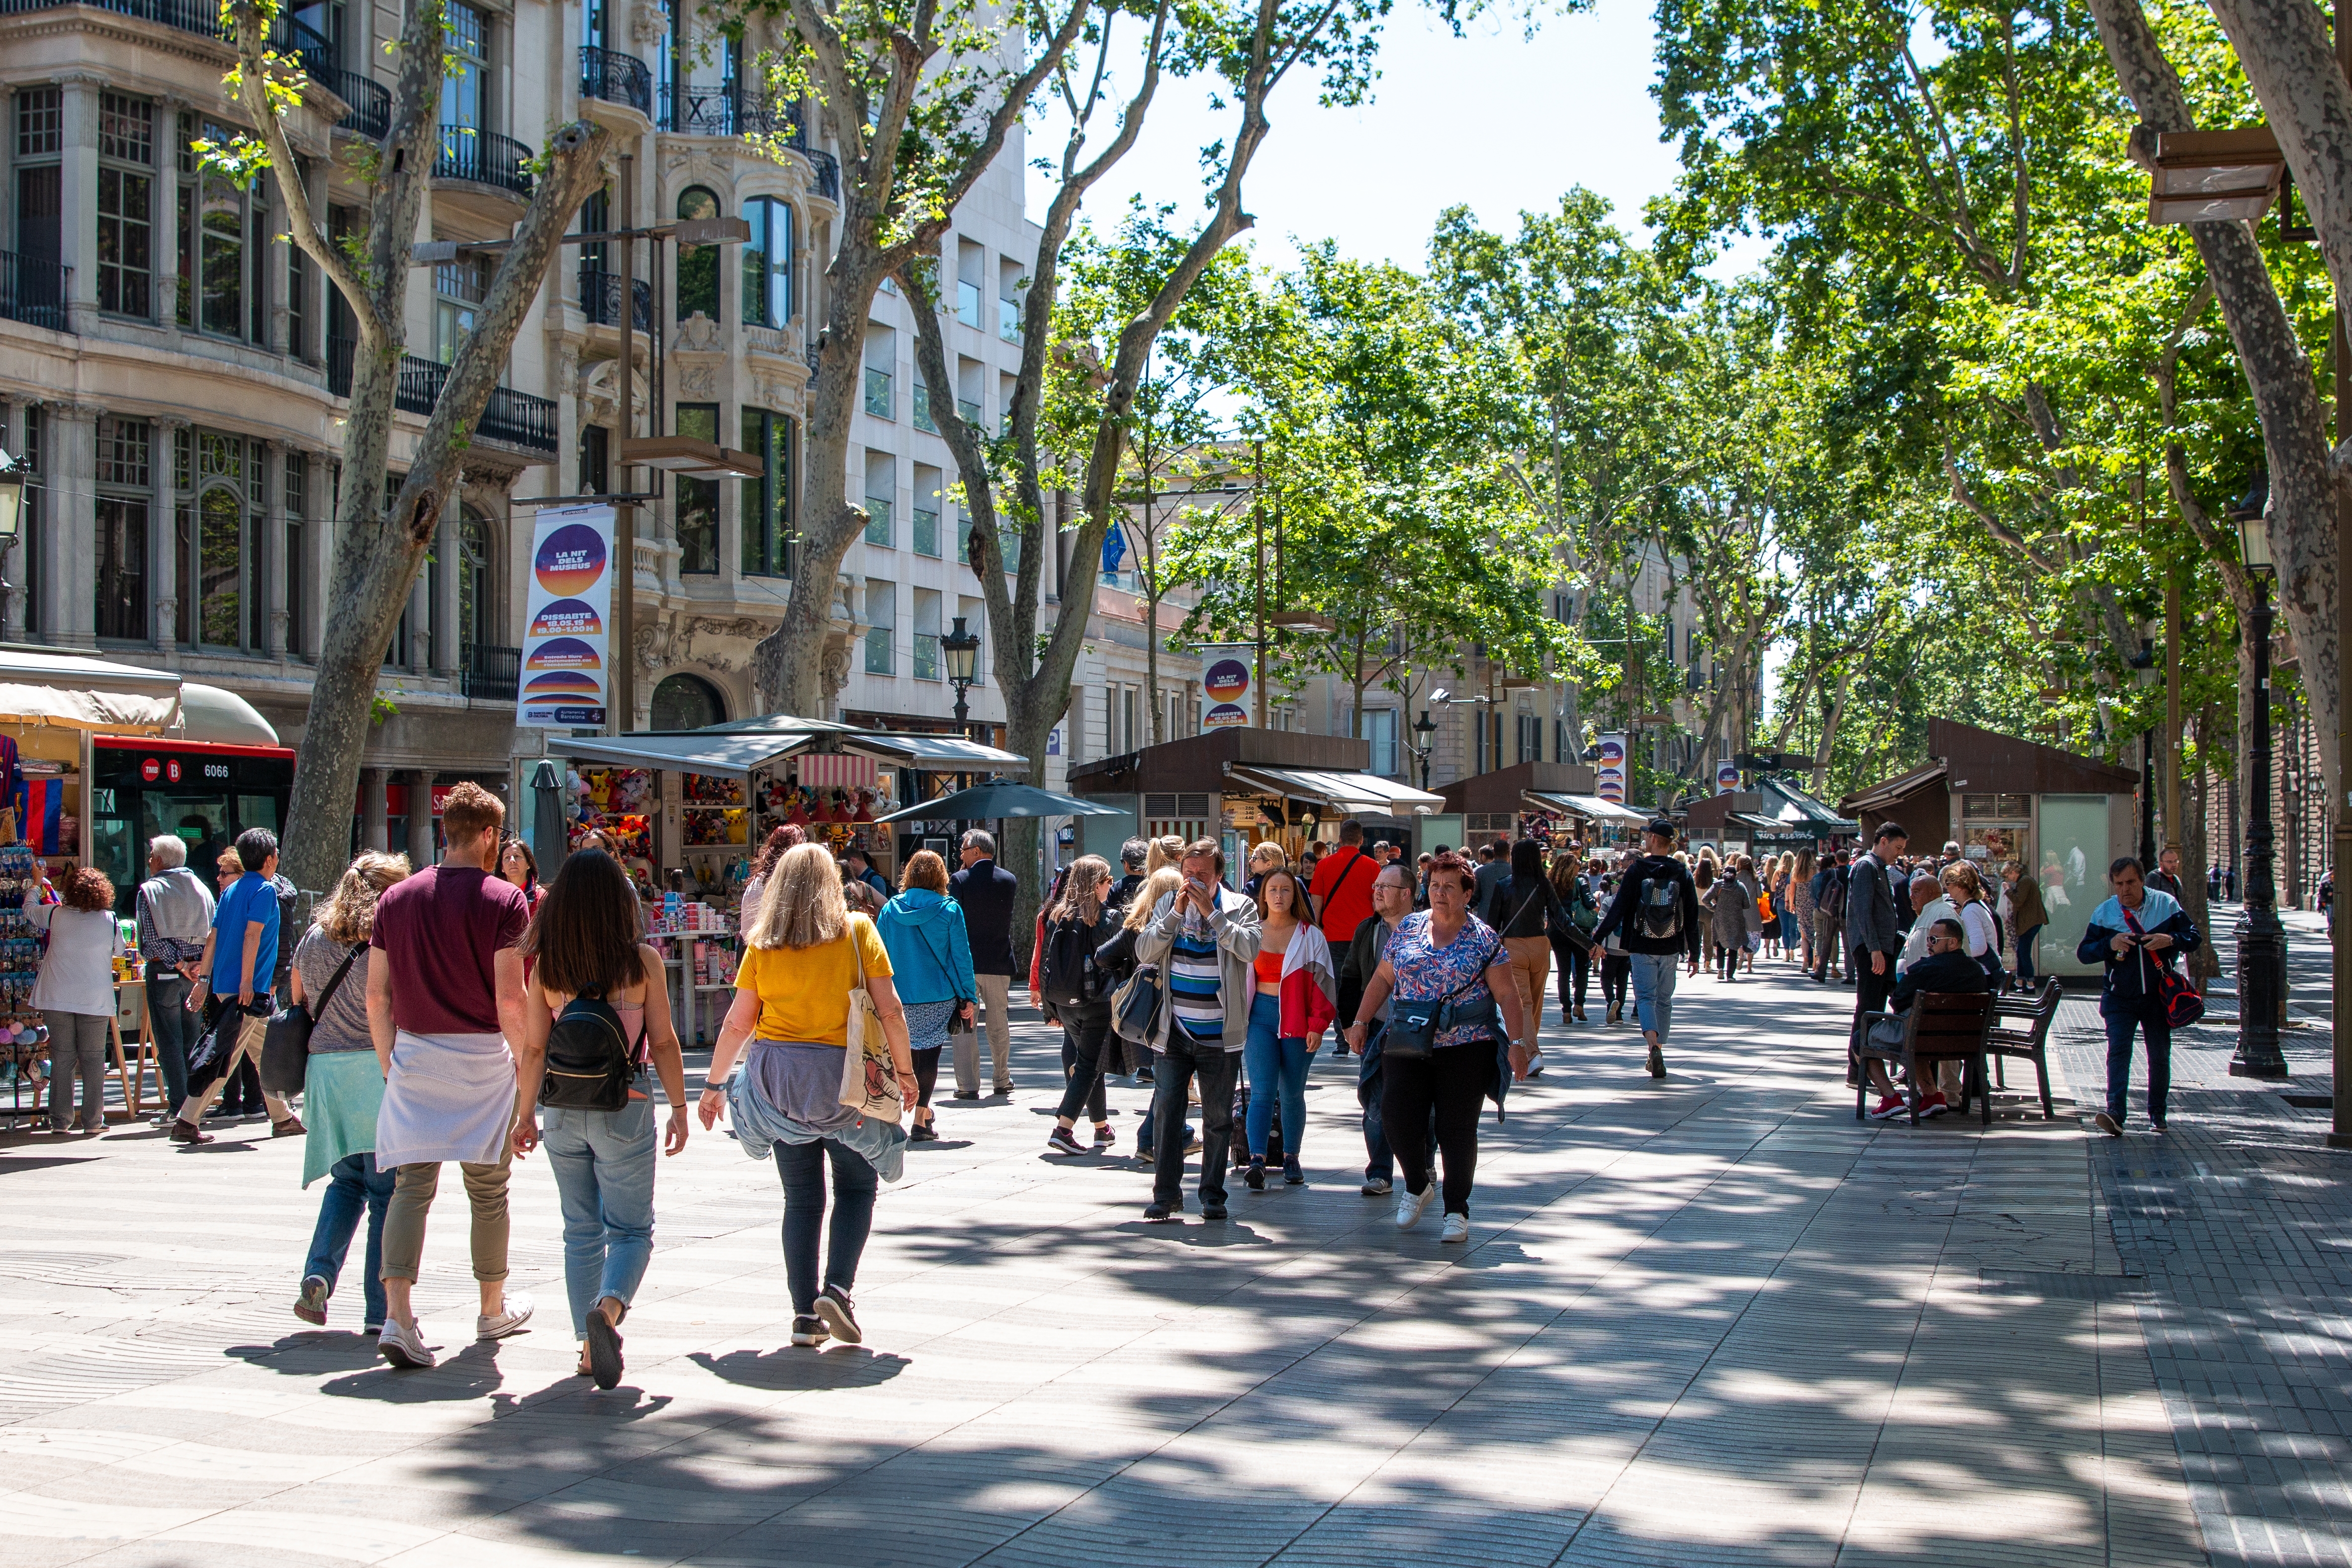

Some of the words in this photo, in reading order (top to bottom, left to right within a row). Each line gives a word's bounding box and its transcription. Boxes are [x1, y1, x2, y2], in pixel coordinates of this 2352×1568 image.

[549, 562, 591, 571] MUSEUS
[1046, 732, 1058, 752] P
[205, 764, 228, 778] 6066
